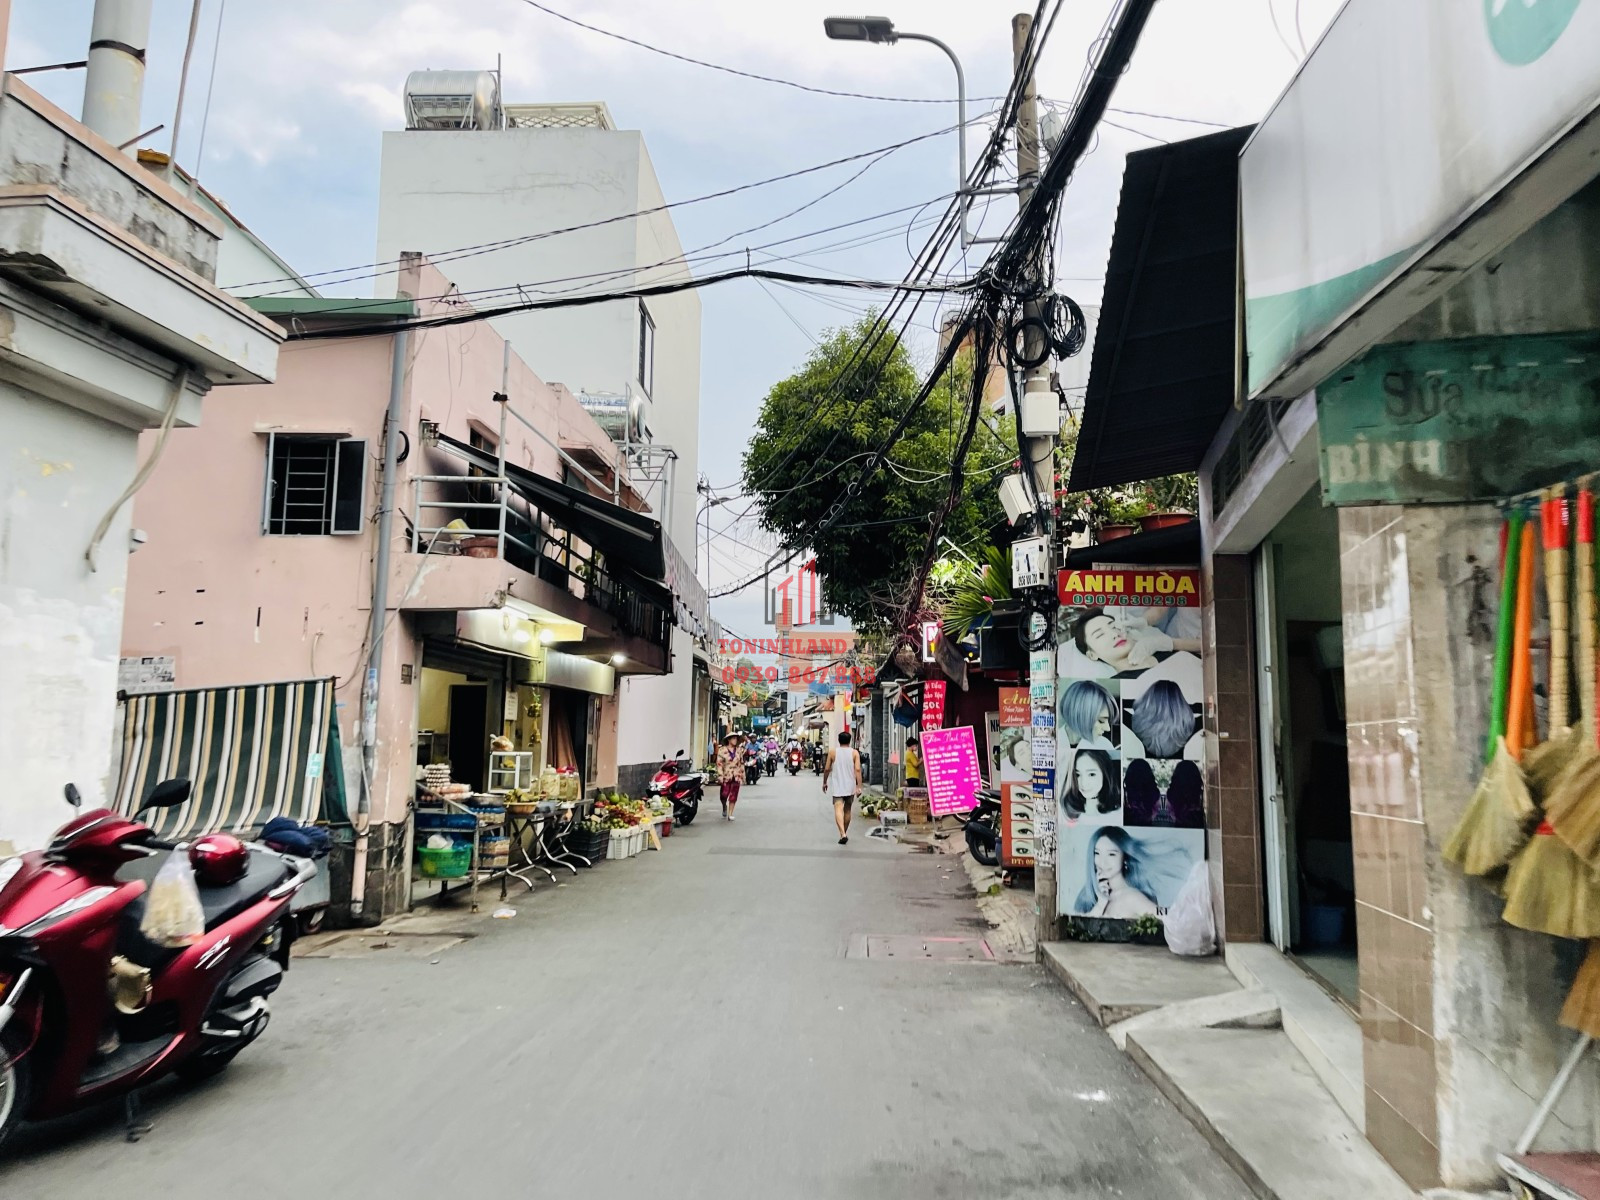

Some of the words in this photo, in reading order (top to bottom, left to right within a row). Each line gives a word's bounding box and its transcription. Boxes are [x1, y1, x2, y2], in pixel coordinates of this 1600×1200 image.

[1064, 571, 1124, 592] ÁNH
[1135, 572, 1196, 594] HÒA
[1072, 594, 1188, 606] 0907630298
